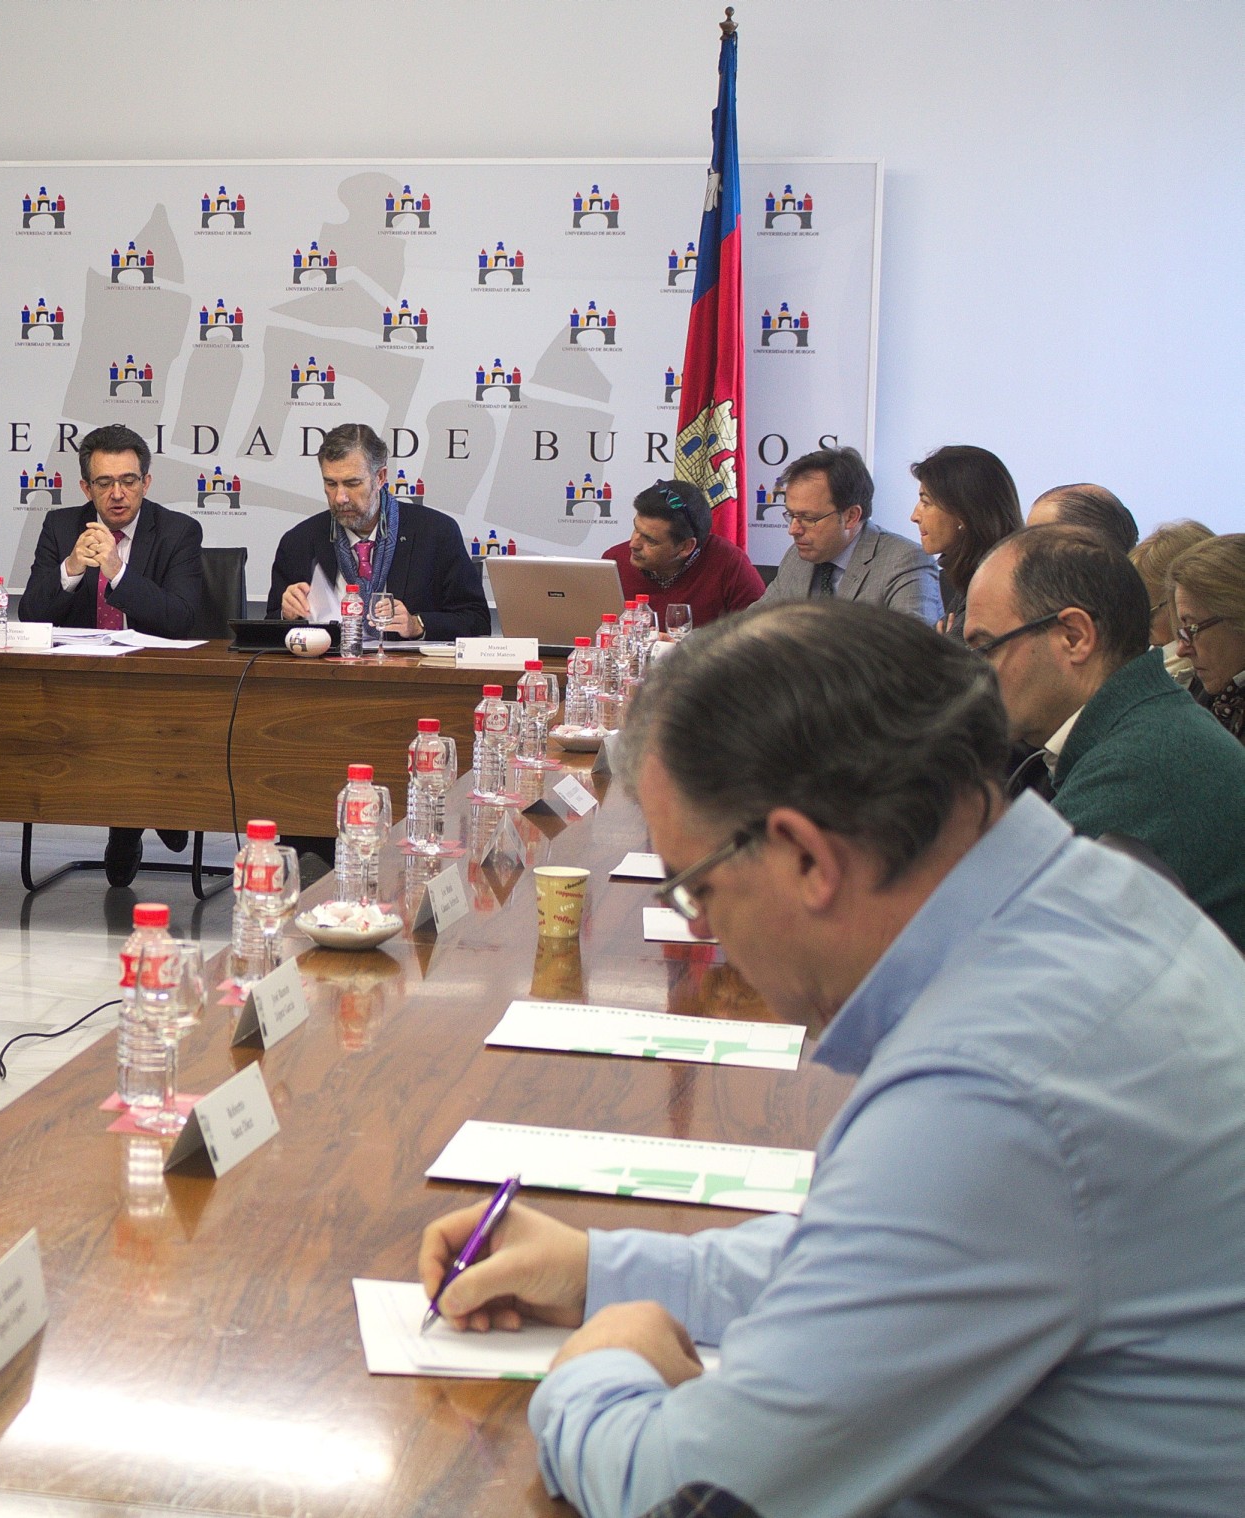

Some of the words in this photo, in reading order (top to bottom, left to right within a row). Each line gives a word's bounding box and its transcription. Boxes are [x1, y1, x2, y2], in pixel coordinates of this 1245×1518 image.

[390, 427, 470, 459] DE
[532, 430, 840, 466] BUROS
[560, 903, 574, 912] tea
[554, 914, 575, 925] coffee
